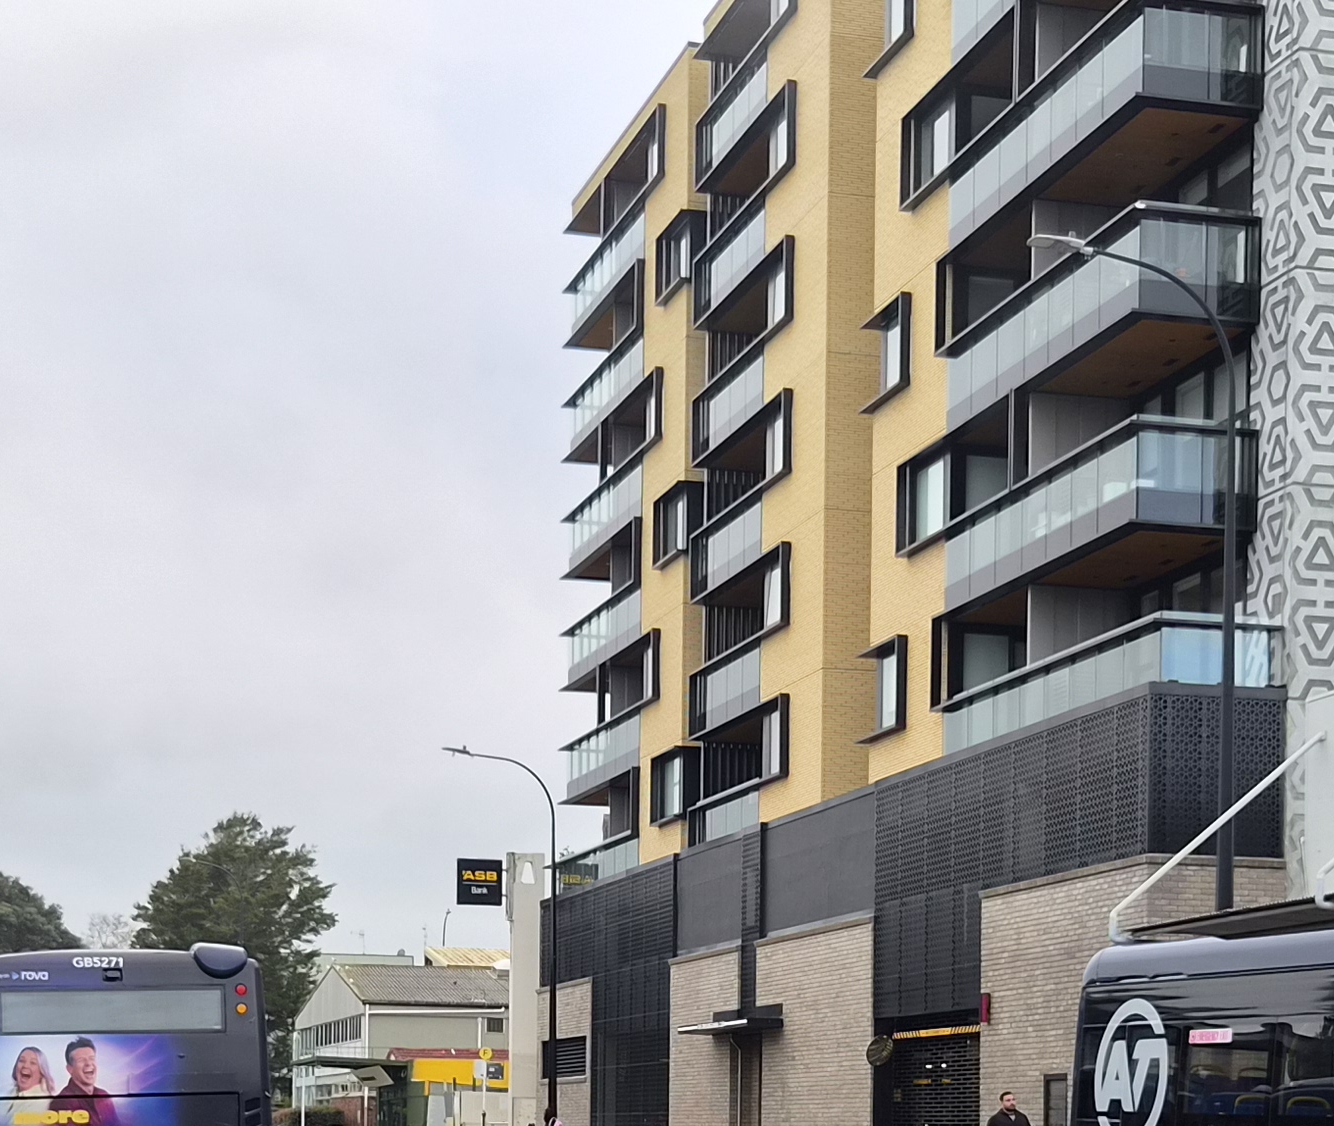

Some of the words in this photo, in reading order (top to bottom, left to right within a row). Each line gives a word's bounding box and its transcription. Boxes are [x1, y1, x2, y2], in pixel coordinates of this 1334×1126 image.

[462, 870, 498, 881] ASB
[471, 886, 488, 894] Bank
[72, 956, 124, 968] GB5271
[20, 971, 49, 981] rova
[13, 1109, 90, 1125] more
